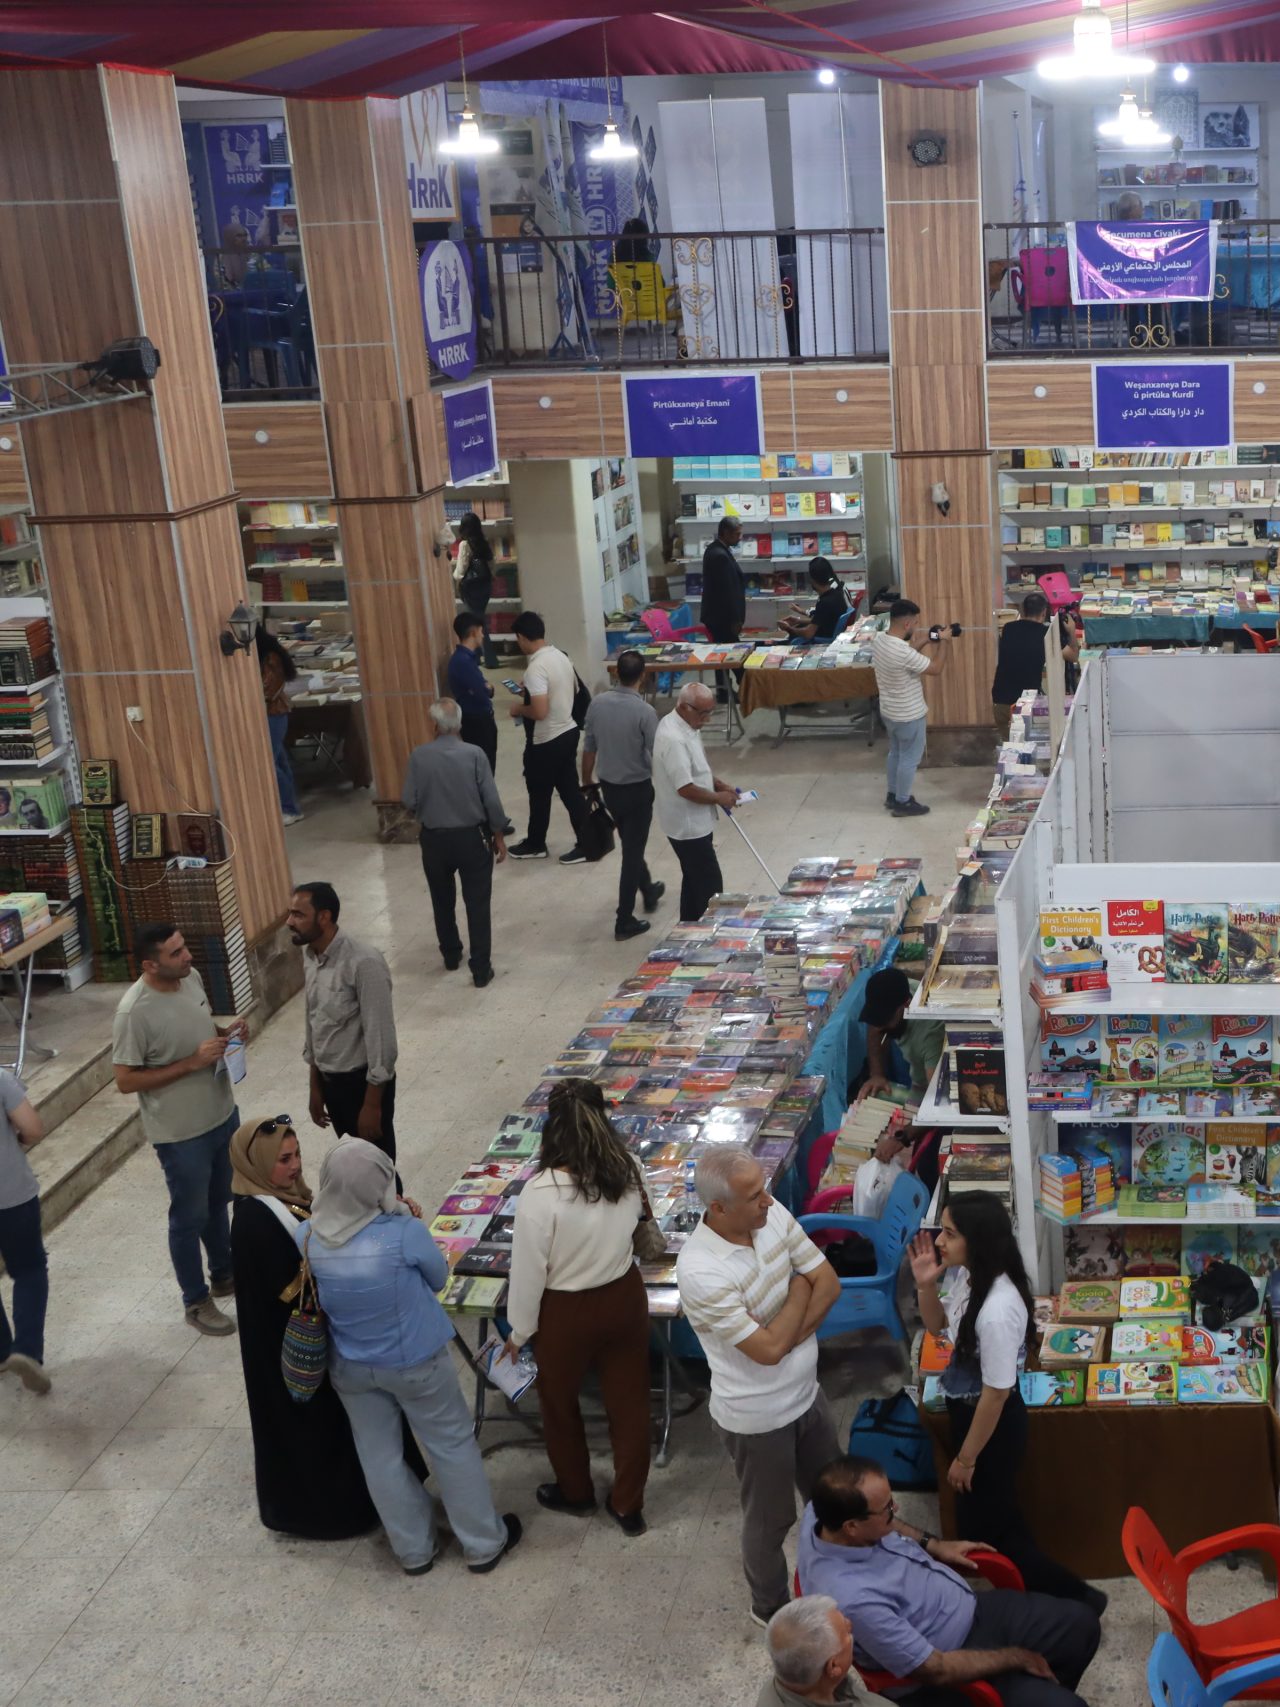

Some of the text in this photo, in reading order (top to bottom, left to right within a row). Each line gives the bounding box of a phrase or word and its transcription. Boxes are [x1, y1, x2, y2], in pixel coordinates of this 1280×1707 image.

[226, 173, 264, 184] HRRK
[1162, 260, 1192, 272] المجلس
[438, 342, 470, 368] HRRK
[1125, 381, 1179, 391] Weşanxaneya
[1122, 408, 1147, 420] الكردي
[1149, 408, 1176, 418] والكتاب
[1194, 408, 1204, 418] دار
[697, 417, 717, 427] مكتبة
[1042, 915, 1099, 924] First Children's
[1171, 913, 1194, 926] Harry
[1234, 913, 1257, 925] Harry
[1051, 925, 1092, 935] Dictionary
[1112, 1016, 1149, 1031] Rona
[1136, 1122, 1202, 1148] First Atlas
[1133, 1287, 1143, 1301] 100
[1126, 1331, 1135, 1346] 100
